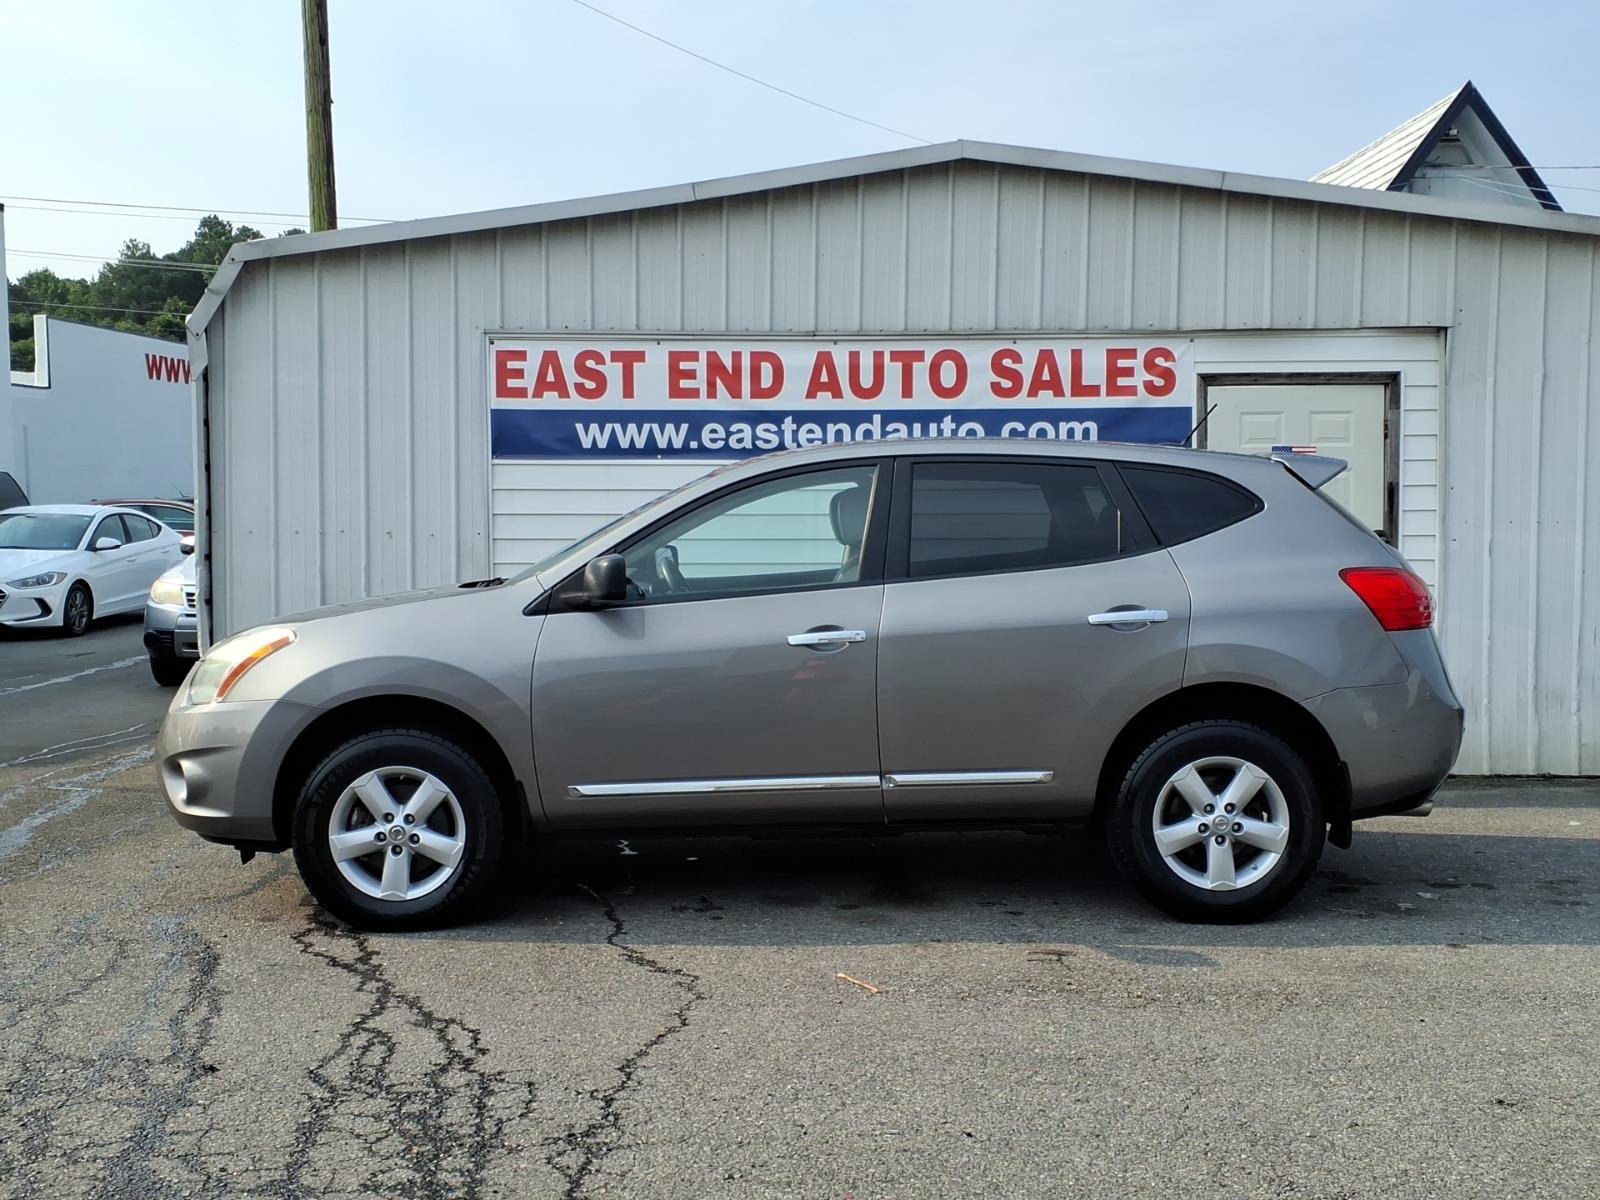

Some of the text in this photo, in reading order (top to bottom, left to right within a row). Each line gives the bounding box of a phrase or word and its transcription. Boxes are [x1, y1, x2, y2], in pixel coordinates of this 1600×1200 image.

[495, 347, 1177, 400] EAST END AUTO SALES
[575, 414, 1098, 449] www.eastendautocom
